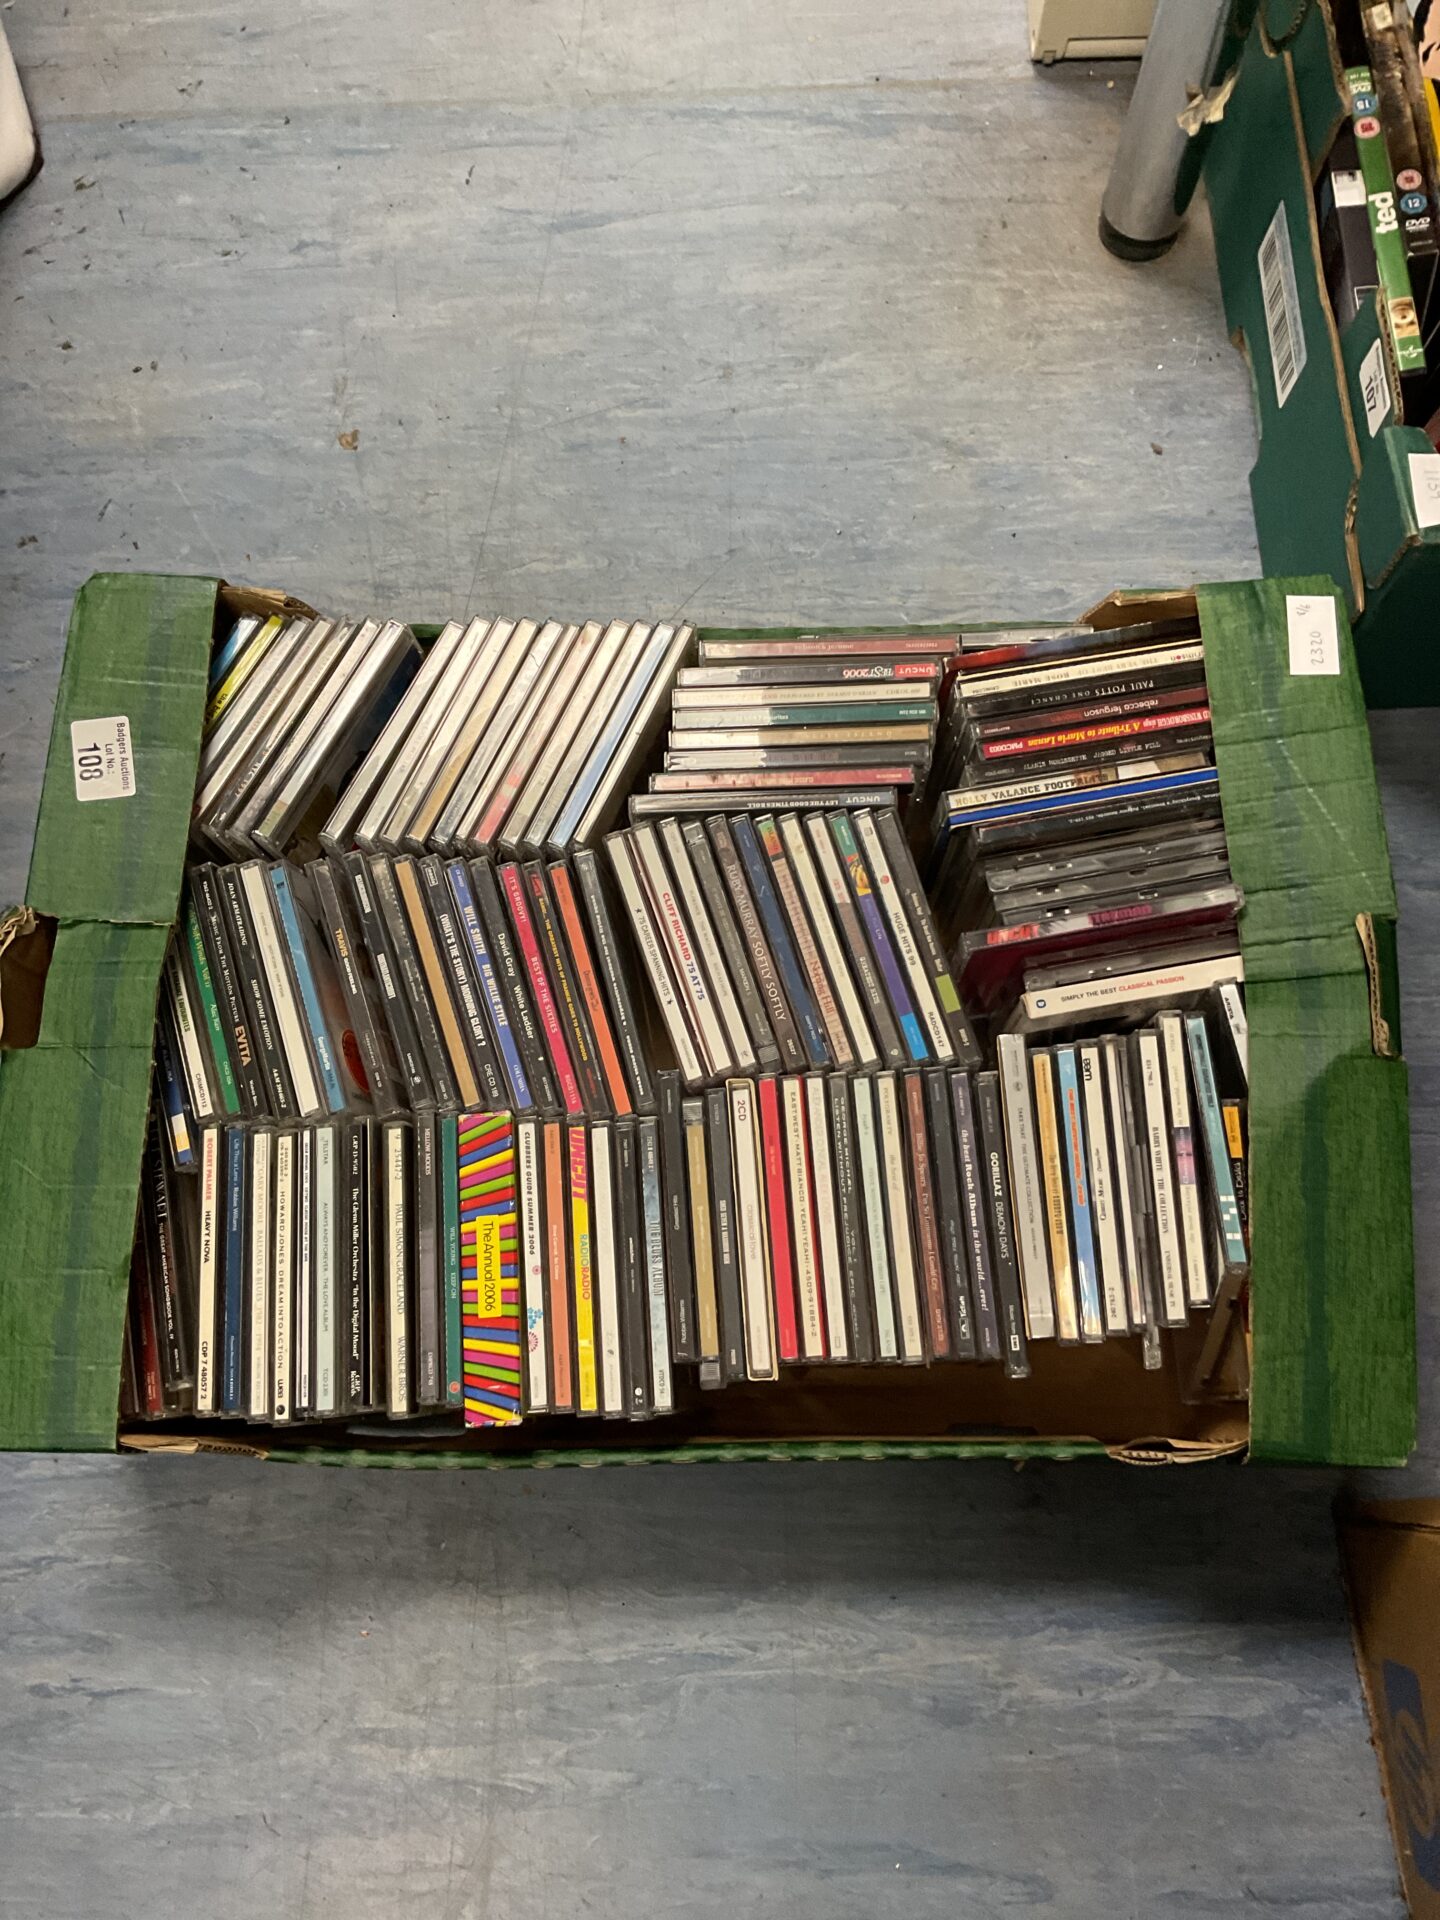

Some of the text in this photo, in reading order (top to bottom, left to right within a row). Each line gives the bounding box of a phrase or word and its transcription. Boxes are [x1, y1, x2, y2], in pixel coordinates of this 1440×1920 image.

[1368, 191, 1399, 234] ted
[1407, 198, 1421, 209] 12
[1365, 376, 1377, 412] 107
[1310, 630, 1325, 666] 2320
[1094, 679, 1154, 696] PAUL POTTS
[1083, 698, 1159, 718] rebecca ferguson
[78, 742, 104, 781] 108
[105, 743, 114, 755] Lot
[116, 722, 130, 790] Badgers Auctions
[845, 795, 880, 803] UNCUT
[226, 881, 248, 946] JOAN ARMATRADING
[512, 891, 526, 923] GROOVY!
[439, 912, 456, 944] (WHAT'S
[543, 918, 551, 930] THE
[892, 911, 916, 966] HUGE HITS 99
[985, 923, 1041, 944] UNCUT
[334, 927, 348, 957] TRAVIS
[448, 943, 460, 958] THE
[547, 929, 559, 958] GREATEST
[637, 915, 670, 997] 75 CAREER SPANNING HITS
[661, 891, 705, 1000] CLIFF RICHARD 75 AT 75
[725, 863, 787, 1022] RUBY MURRAY SOFTLY SOFTLY
[452, 956, 468, 984] STORY)
[463, 904, 507, 1027] WILL SMITH BIG WILLIE STYLE
[554, 957, 563, 971] HITS
[558, 971, 565, 979] OF
[460, 983, 477, 1017] MORNING
[497, 932, 534, 1039] David Gray White Ladder
[530, 956, 557, 1033] BEST OF THE SIXTIES
[560, 978, 571, 1003] FRANKIE
[1060, 992, 1085, 1001] SIMPLY
[1099, 987, 1117, 995] BEST
[1118, 981, 1154, 991] CLASSICAL
[1156, 975, 1185, 985] PASSION
[250, 978, 273, 1051] SHOW SOME EMOTION
[567, 1002, 576, 1018] GOES
[571, 1018, 578, 1027] TO
[1223, 996, 1234, 1020] ARISTA
[470, 1016, 484, 1040] GLORY
[233, 1024, 252, 1066] EVITA
[574, 1026, 588, 1061] HOLLYWOOD
[1082, 1057, 1092, 1081] wea
[737, 1099, 746, 1121] 2CD
[833, 1097, 841, 1138] LISTEN
[523, 1131, 531, 1168] CLUBBERS
[960, 1128, 969, 1143] the
[569, 1128, 587, 1202] UNCUT
[837, 1141, 846, 1193] WITHOUT
[962, 1143, 971, 1162] best
[964, 1163, 974, 1190] Rock
[351, 1187, 359, 1200] The
[989, 1151, 1009, 1258] GORILLAZ DEMON DAYS
[351, 1201, 359, 1222] Glenn
[394, 1203, 402, 1226] PAUL
[967, 1192, 979, 1227] Album
[351, 1224, 359, 1244] Miller
[395, 1229, 403, 1259] SIMON
[841, 1196, 852, 1263] PREJUDICE
[971, 1228, 980, 1238] in
[973, 1239, 982, 1254] the
[160, 1254, 169, 1283] AMERICAN
[351, 1246, 359, 1280] Orchestra
[482, 1221, 495, 1311] The Annual 2006
[351, 1296, 359, 1308] the
[396, 1261, 404, 1314] GRACELAND
[351, 1309, 359, 1333] Digital
[397, 1336, 405, 1374] WARNER
